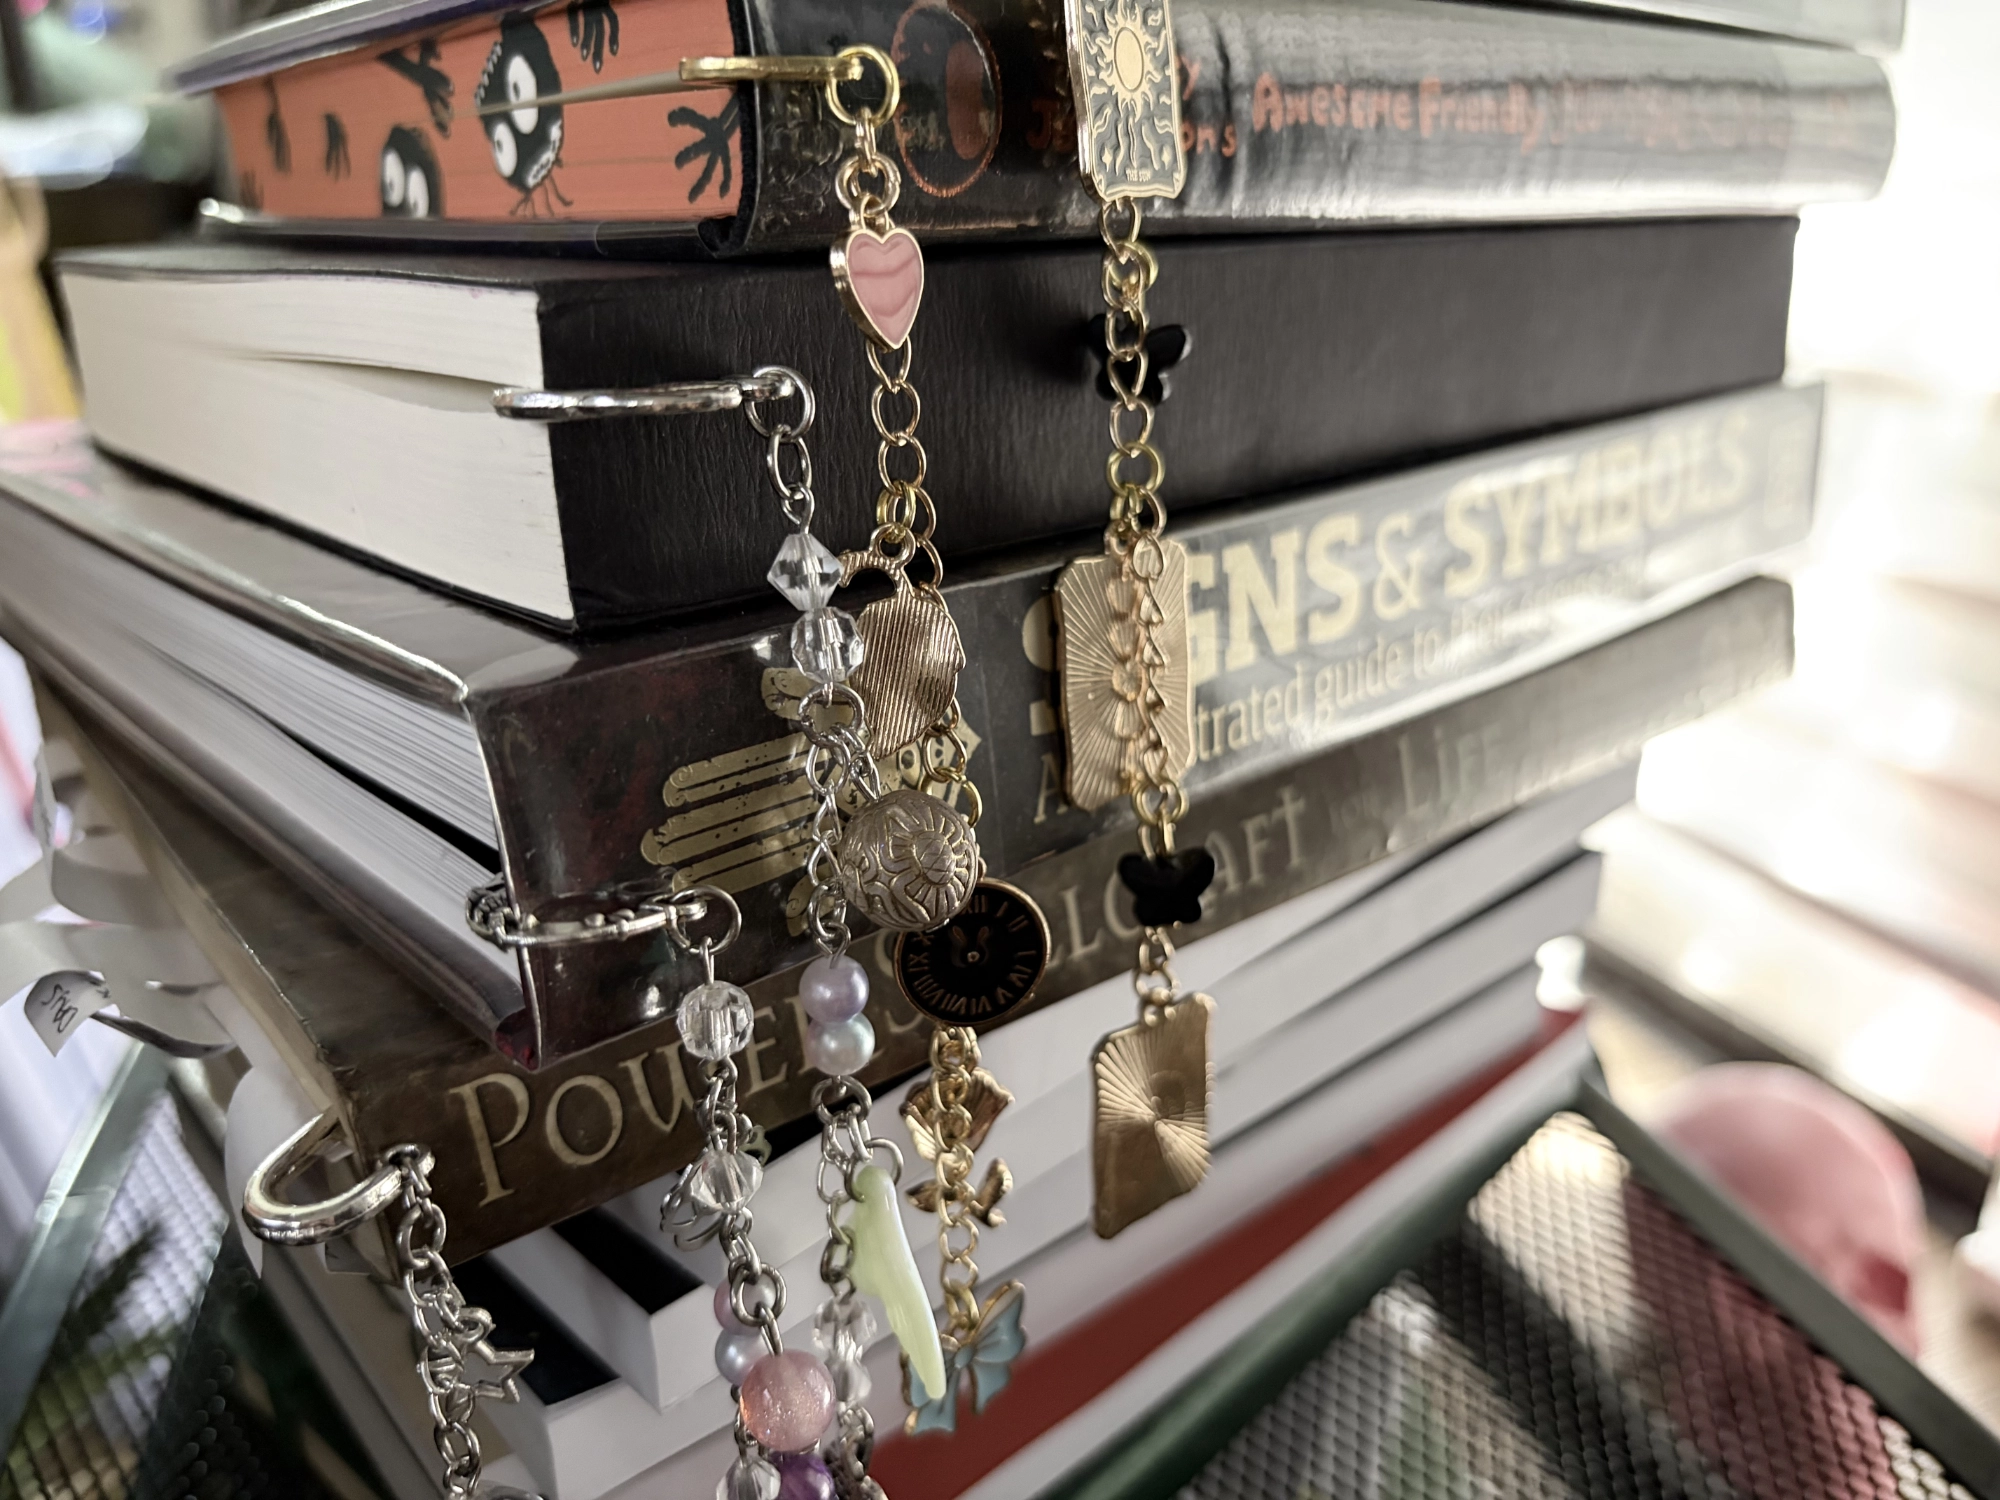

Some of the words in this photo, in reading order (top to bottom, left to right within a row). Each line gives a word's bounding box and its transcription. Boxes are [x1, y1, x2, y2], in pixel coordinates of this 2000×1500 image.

[1372, 515, 1426, 621] &
[1444, 407, 1752, 597] SYMBOLS
[1197, 662, 1304, 762] trated
[1315, 634, 1402, 729] guide
